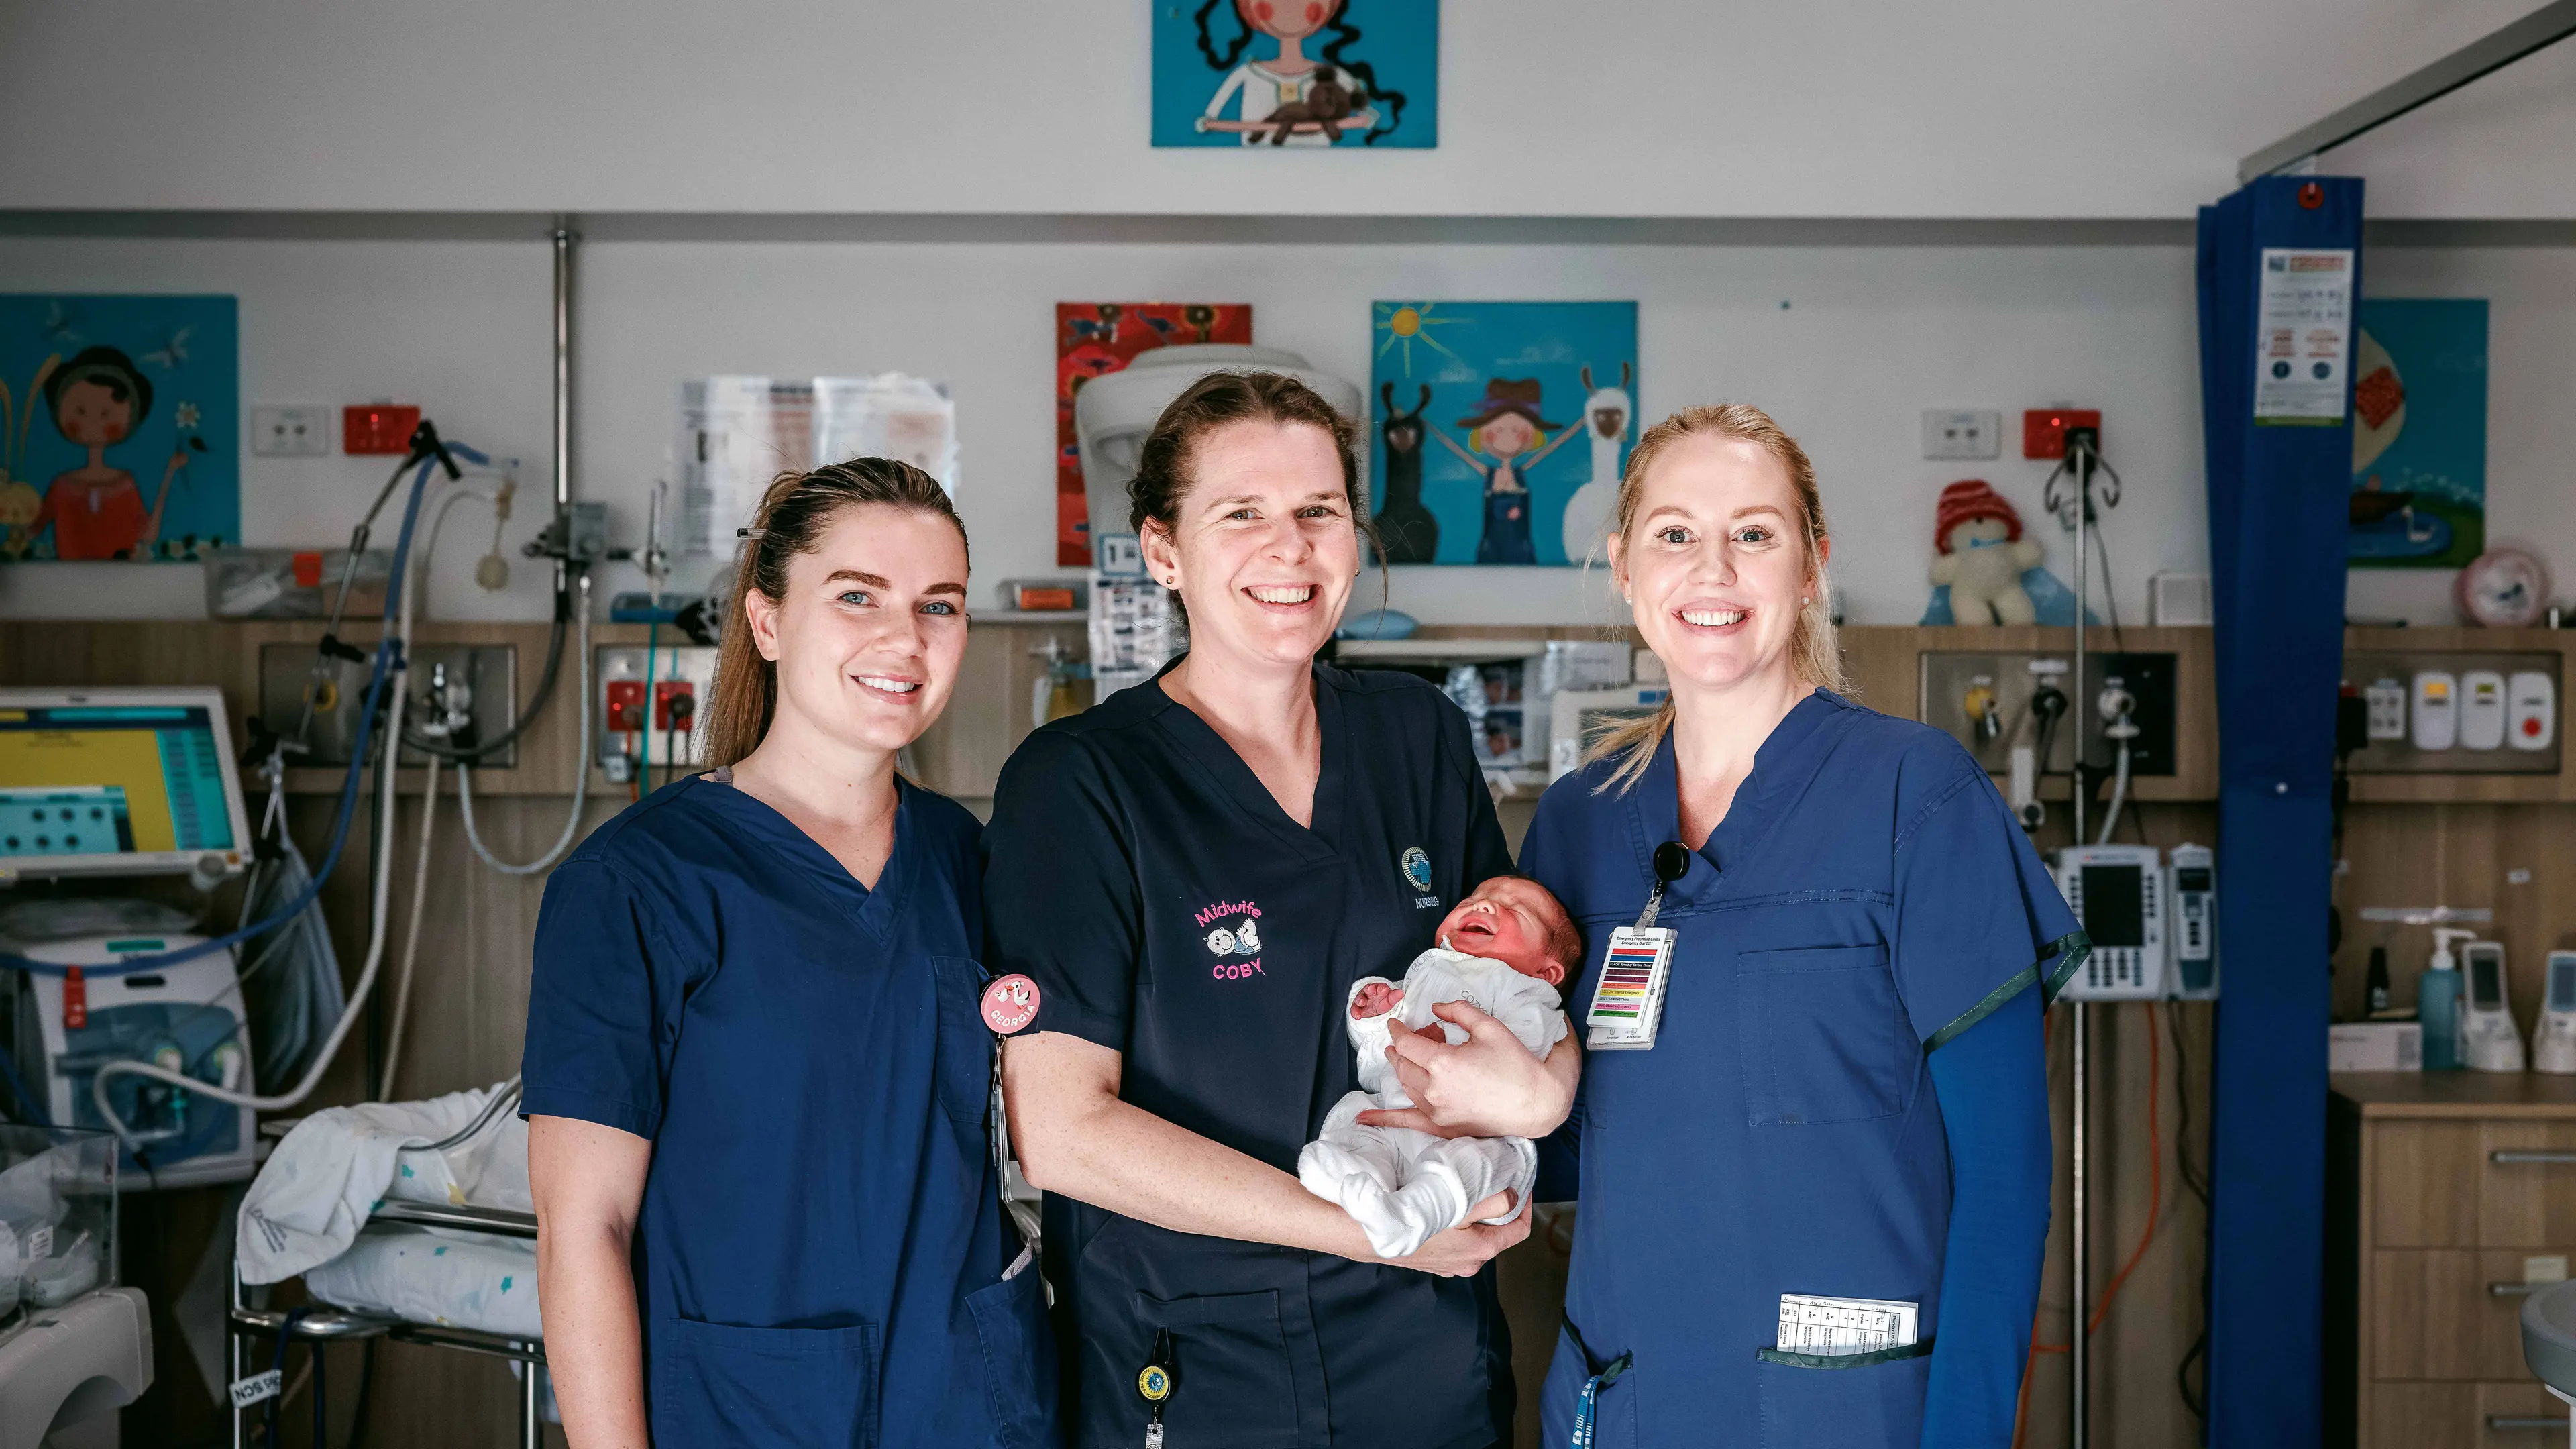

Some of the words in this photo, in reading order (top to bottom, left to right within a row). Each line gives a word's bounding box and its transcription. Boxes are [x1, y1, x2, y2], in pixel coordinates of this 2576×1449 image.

[1415, 896, 1440, 909] NURSING
[1195, 900, 1262, 928] Midwife
[1213, 957, 1262, 979] COBY
[991, 1005, 1035, 1027] GEORGIA
